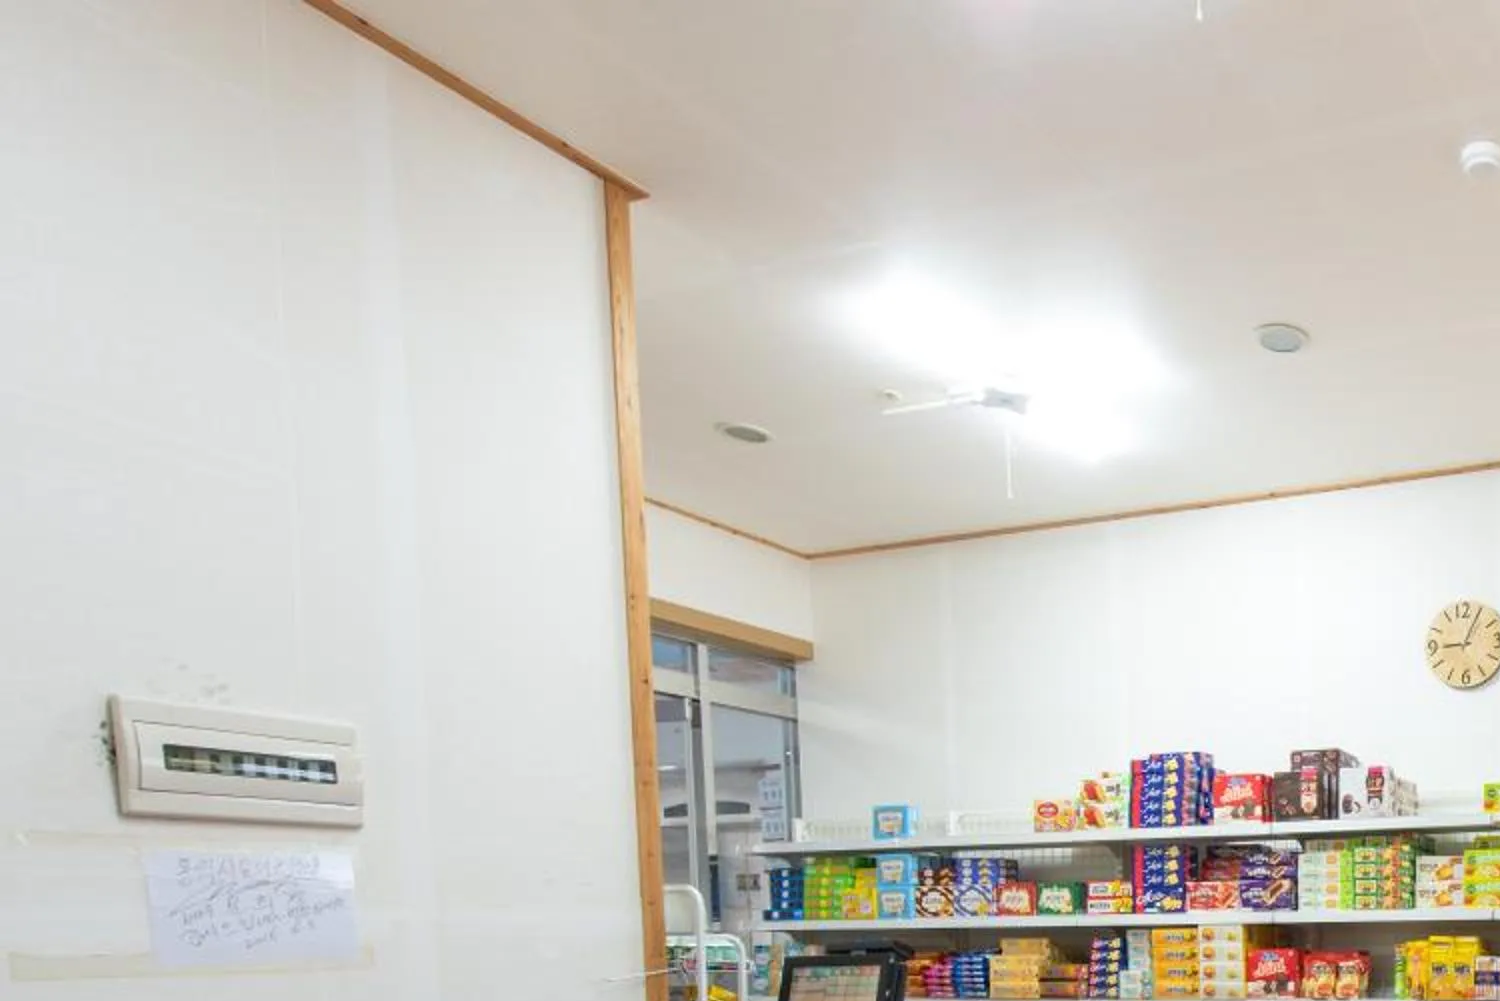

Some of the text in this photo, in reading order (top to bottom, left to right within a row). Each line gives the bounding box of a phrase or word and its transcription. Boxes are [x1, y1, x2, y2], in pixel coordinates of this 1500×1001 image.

[1455, 601, 1470, 619] 12
[1427, 639, 1439, 656] 9
[1461, 669, 1471, 685] 6
